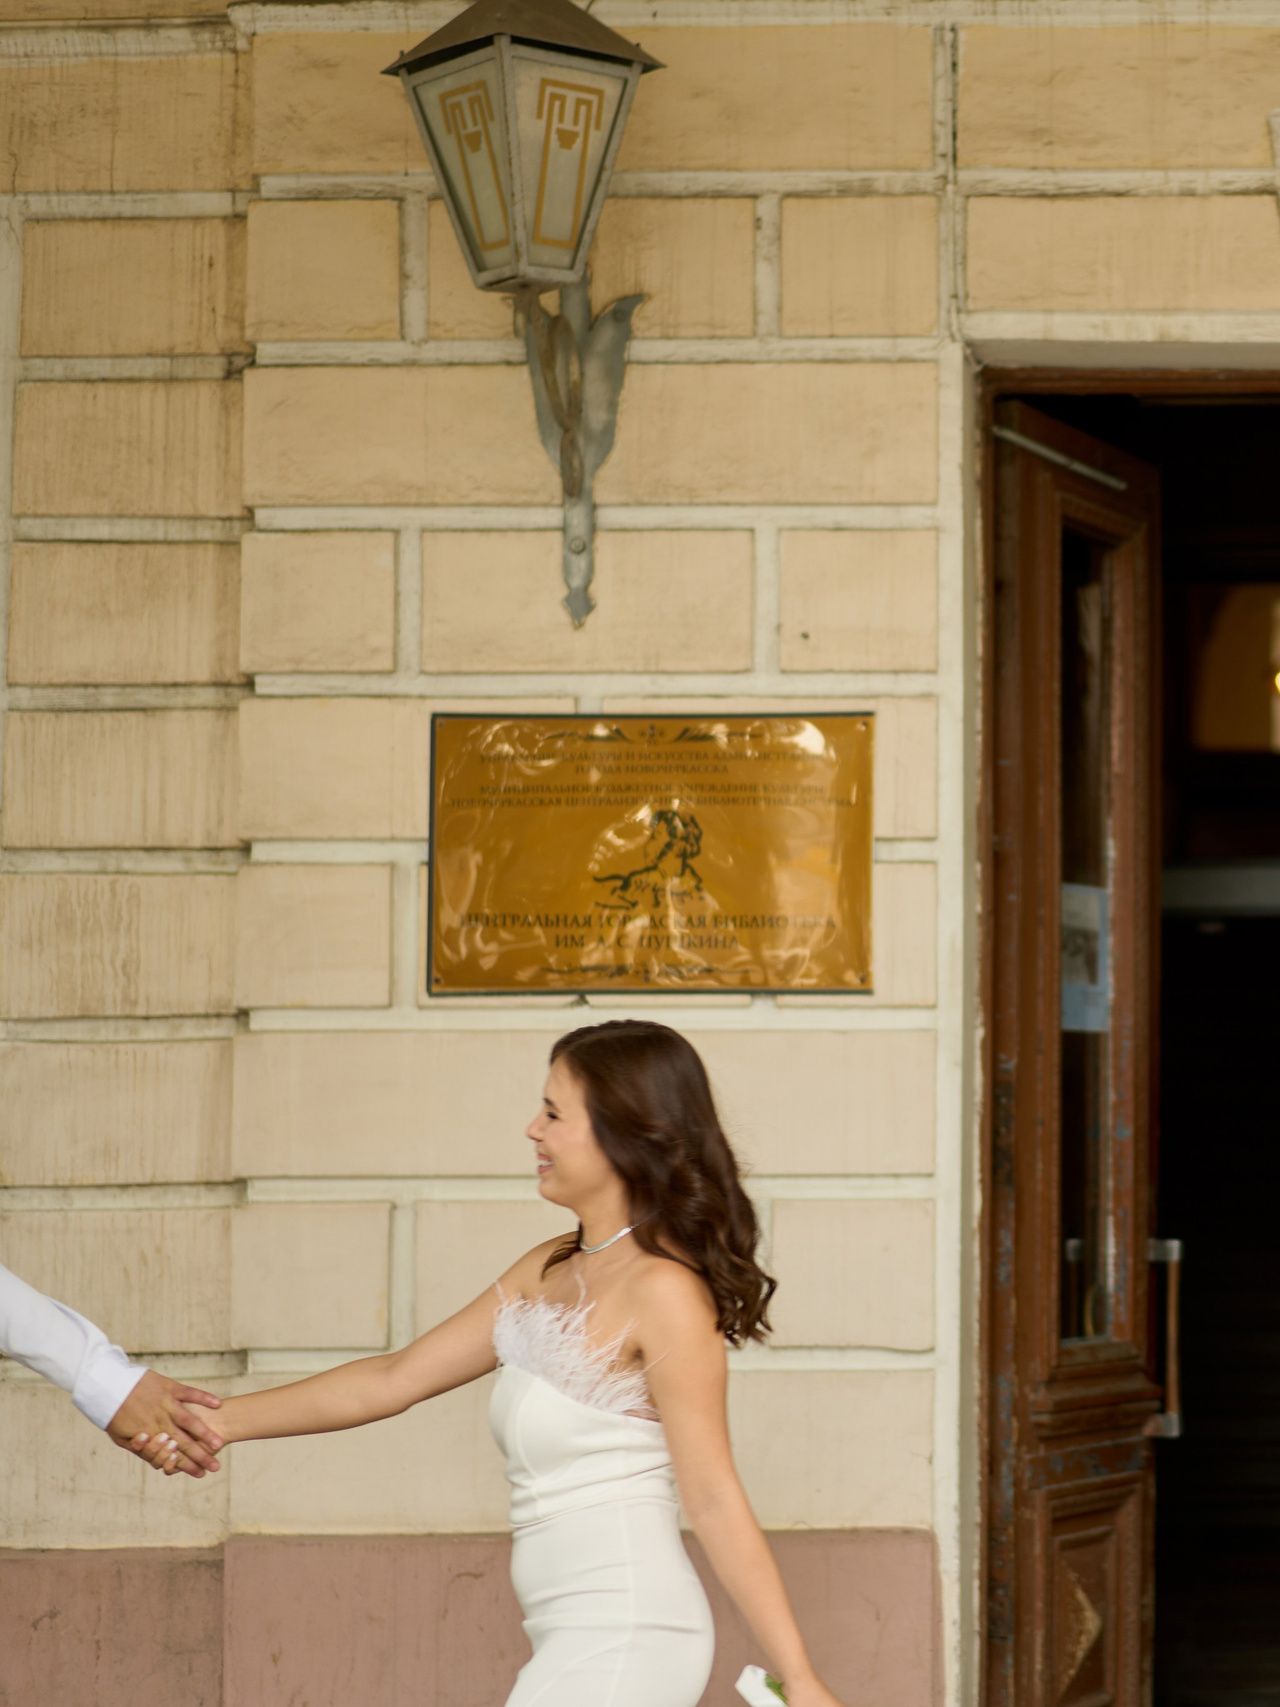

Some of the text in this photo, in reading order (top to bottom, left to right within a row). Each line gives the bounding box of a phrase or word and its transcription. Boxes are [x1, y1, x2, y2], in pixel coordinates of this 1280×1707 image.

[460, 913, 837, 929] ЦЕНТРАЛЬНАЯ ГОРДСКАЯ БИБЛИОТЕКА
[639, 934, 740, 951] ПУШКИНА
